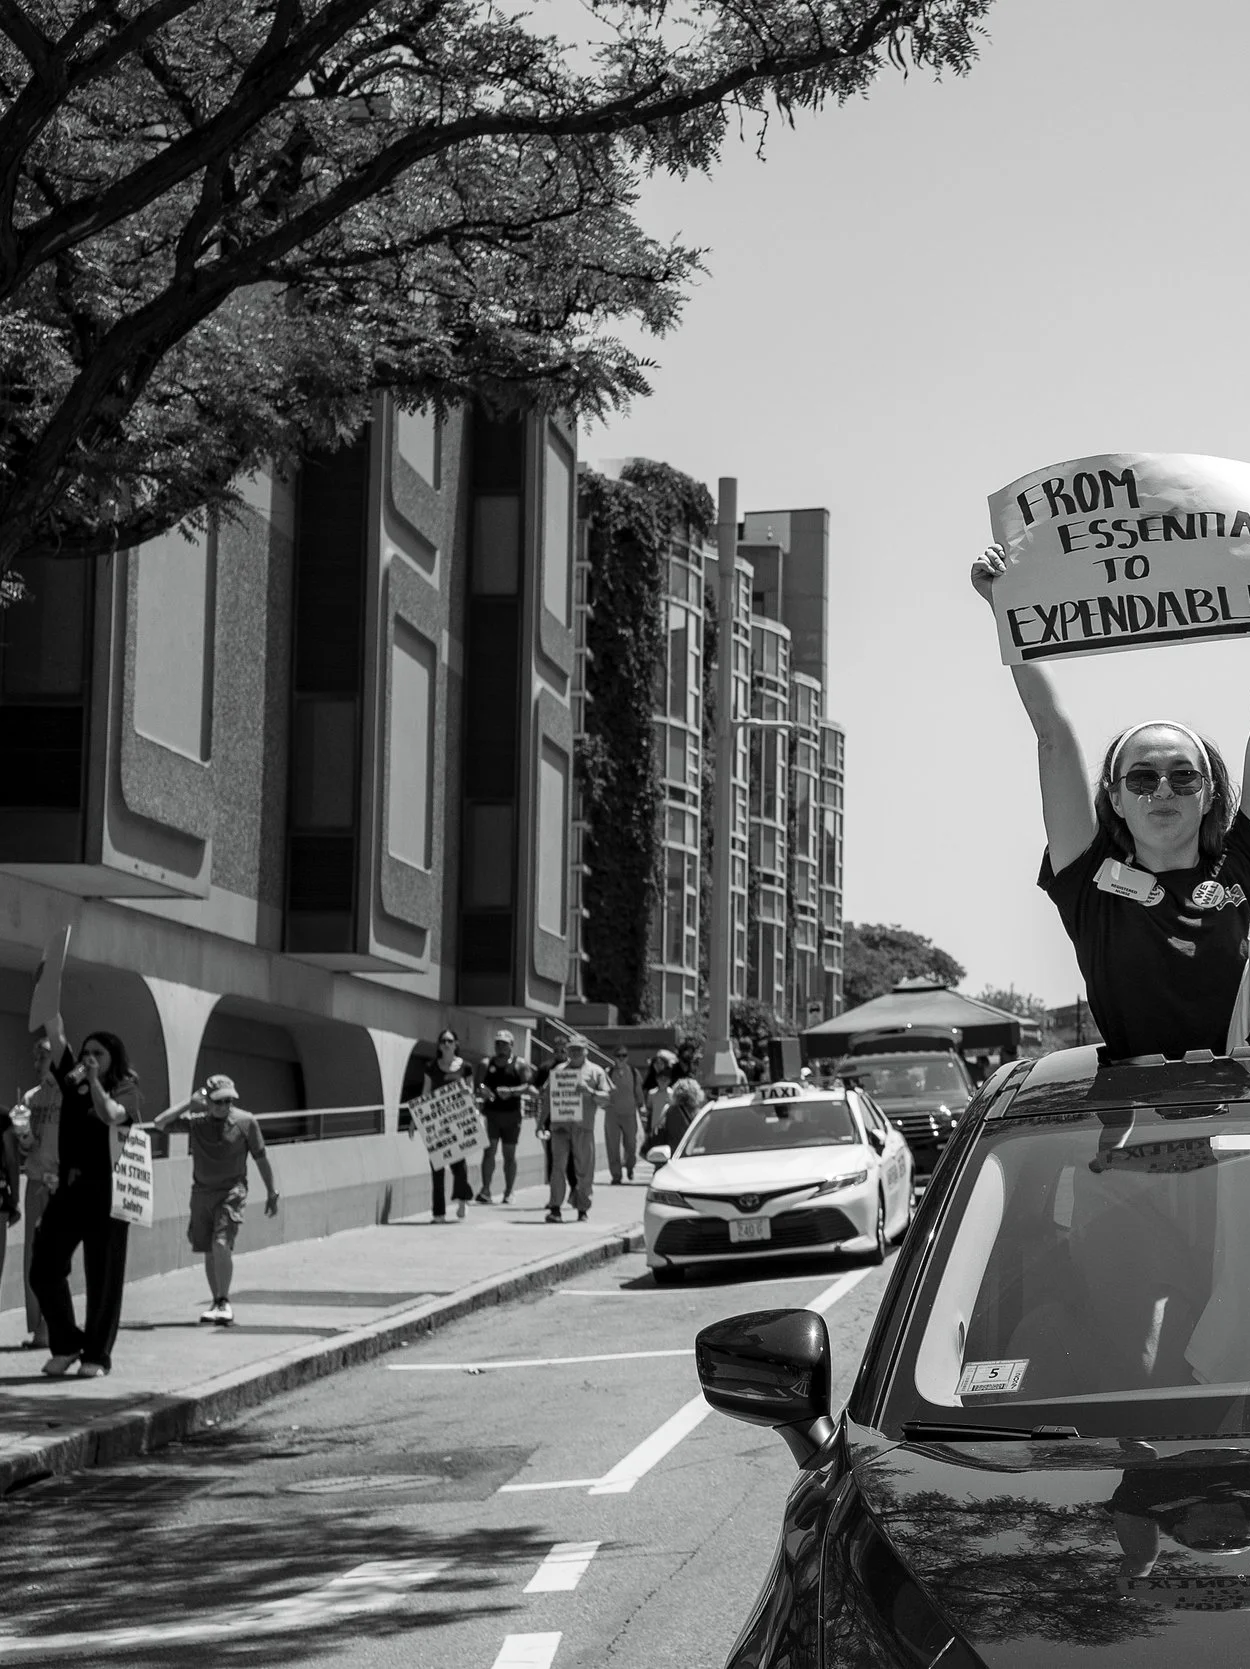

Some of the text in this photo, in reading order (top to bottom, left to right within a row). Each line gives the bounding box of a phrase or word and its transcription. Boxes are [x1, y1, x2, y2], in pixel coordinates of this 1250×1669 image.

[1016, 468, 1140, 525] FROM
[1093, 555, 1149, 583] TO
[1111, 883, 1138, 894] REGISTERED
[1194, 884, 1209, 899] WE
[1201, 884, 1219, 905] WILL
[760, 1087, 796, 1099] TAXI
[421, 1100, 466, 1124] PROTECTED
[114, 1162, 151, 1184] ON STRIKE
[127, 1182, 150, 1200] Patient
[122, 1198, 143, 1216] Safety
[988, 1367, 1000, 1378] 5
